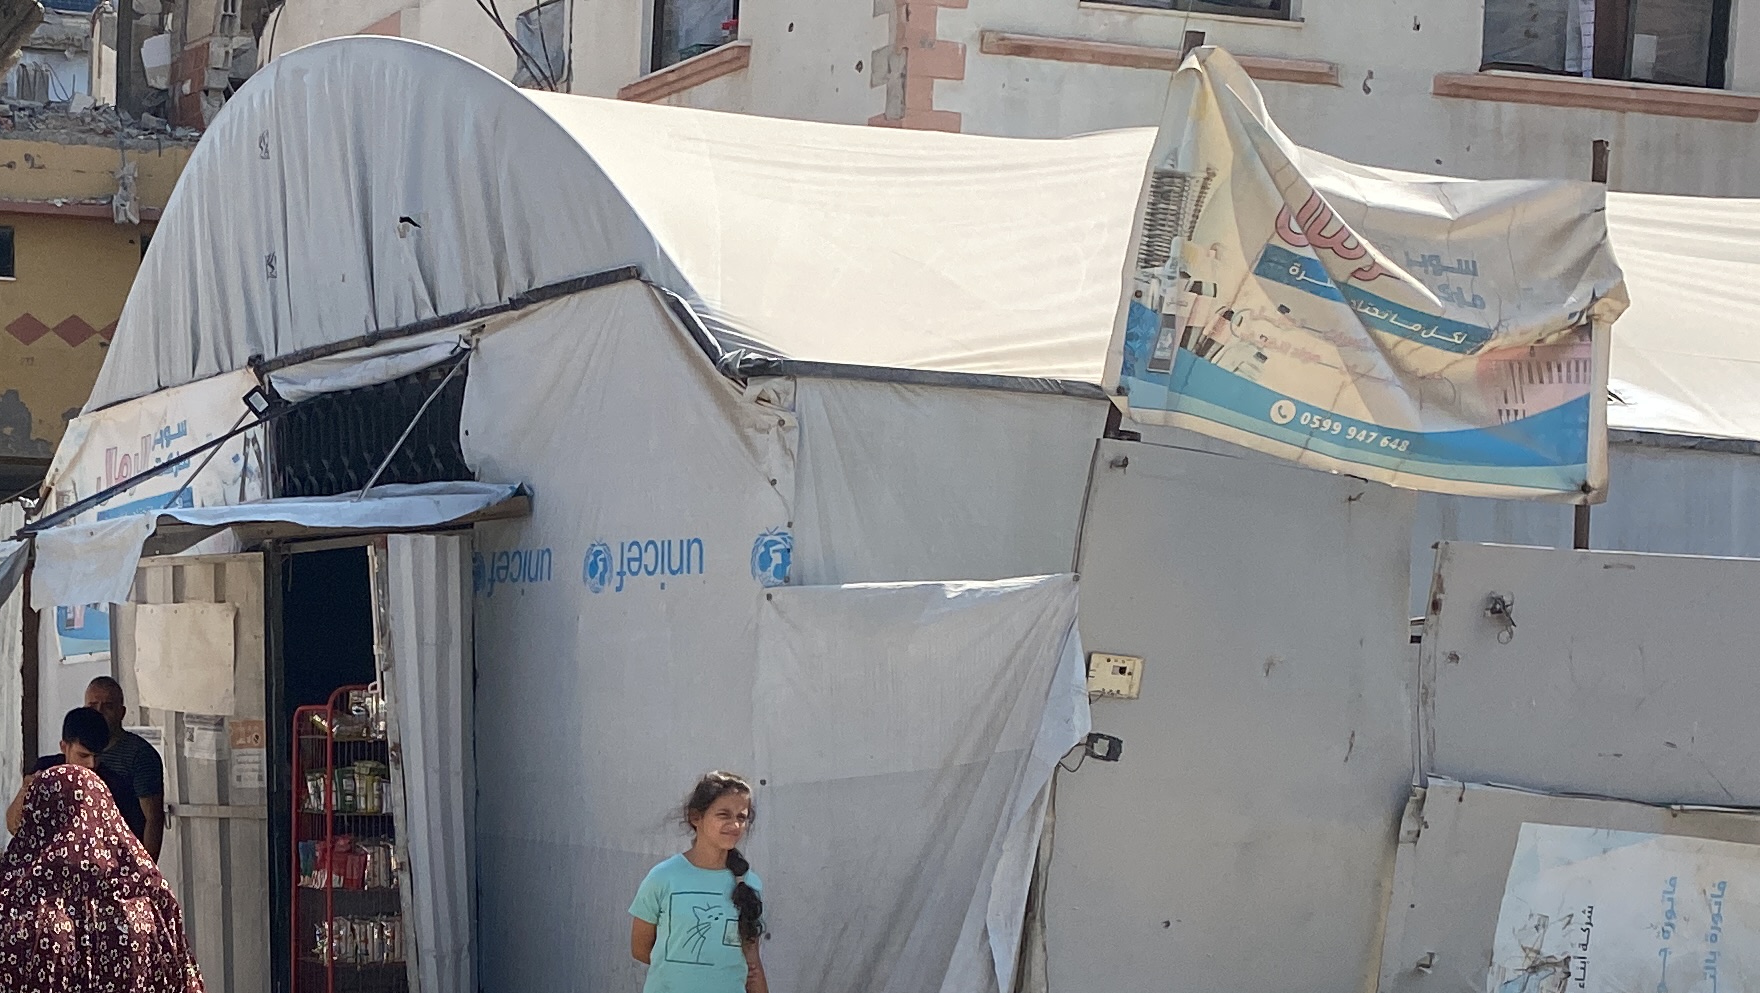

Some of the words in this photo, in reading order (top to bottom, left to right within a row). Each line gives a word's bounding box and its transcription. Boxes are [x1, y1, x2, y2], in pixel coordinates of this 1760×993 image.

[1389, 314, 1423, 333] ما
[1422, 327, 1468, 345] لكل
[1299, 411, 1342, 434] 0599
[1345, 426, 1379, 444] 947
[1379, 435, 1411, 452] 648
[487, 547, 553, 598] unicef
[614, 537, 704, 593] unicef
[1573, 905, 1594, 952] شركة
[1656, 876, 1678, 940] فاتورة
[1705, 880, 1728, 943] فاتورة
[1572, 955, 1591, 989] أبناء
